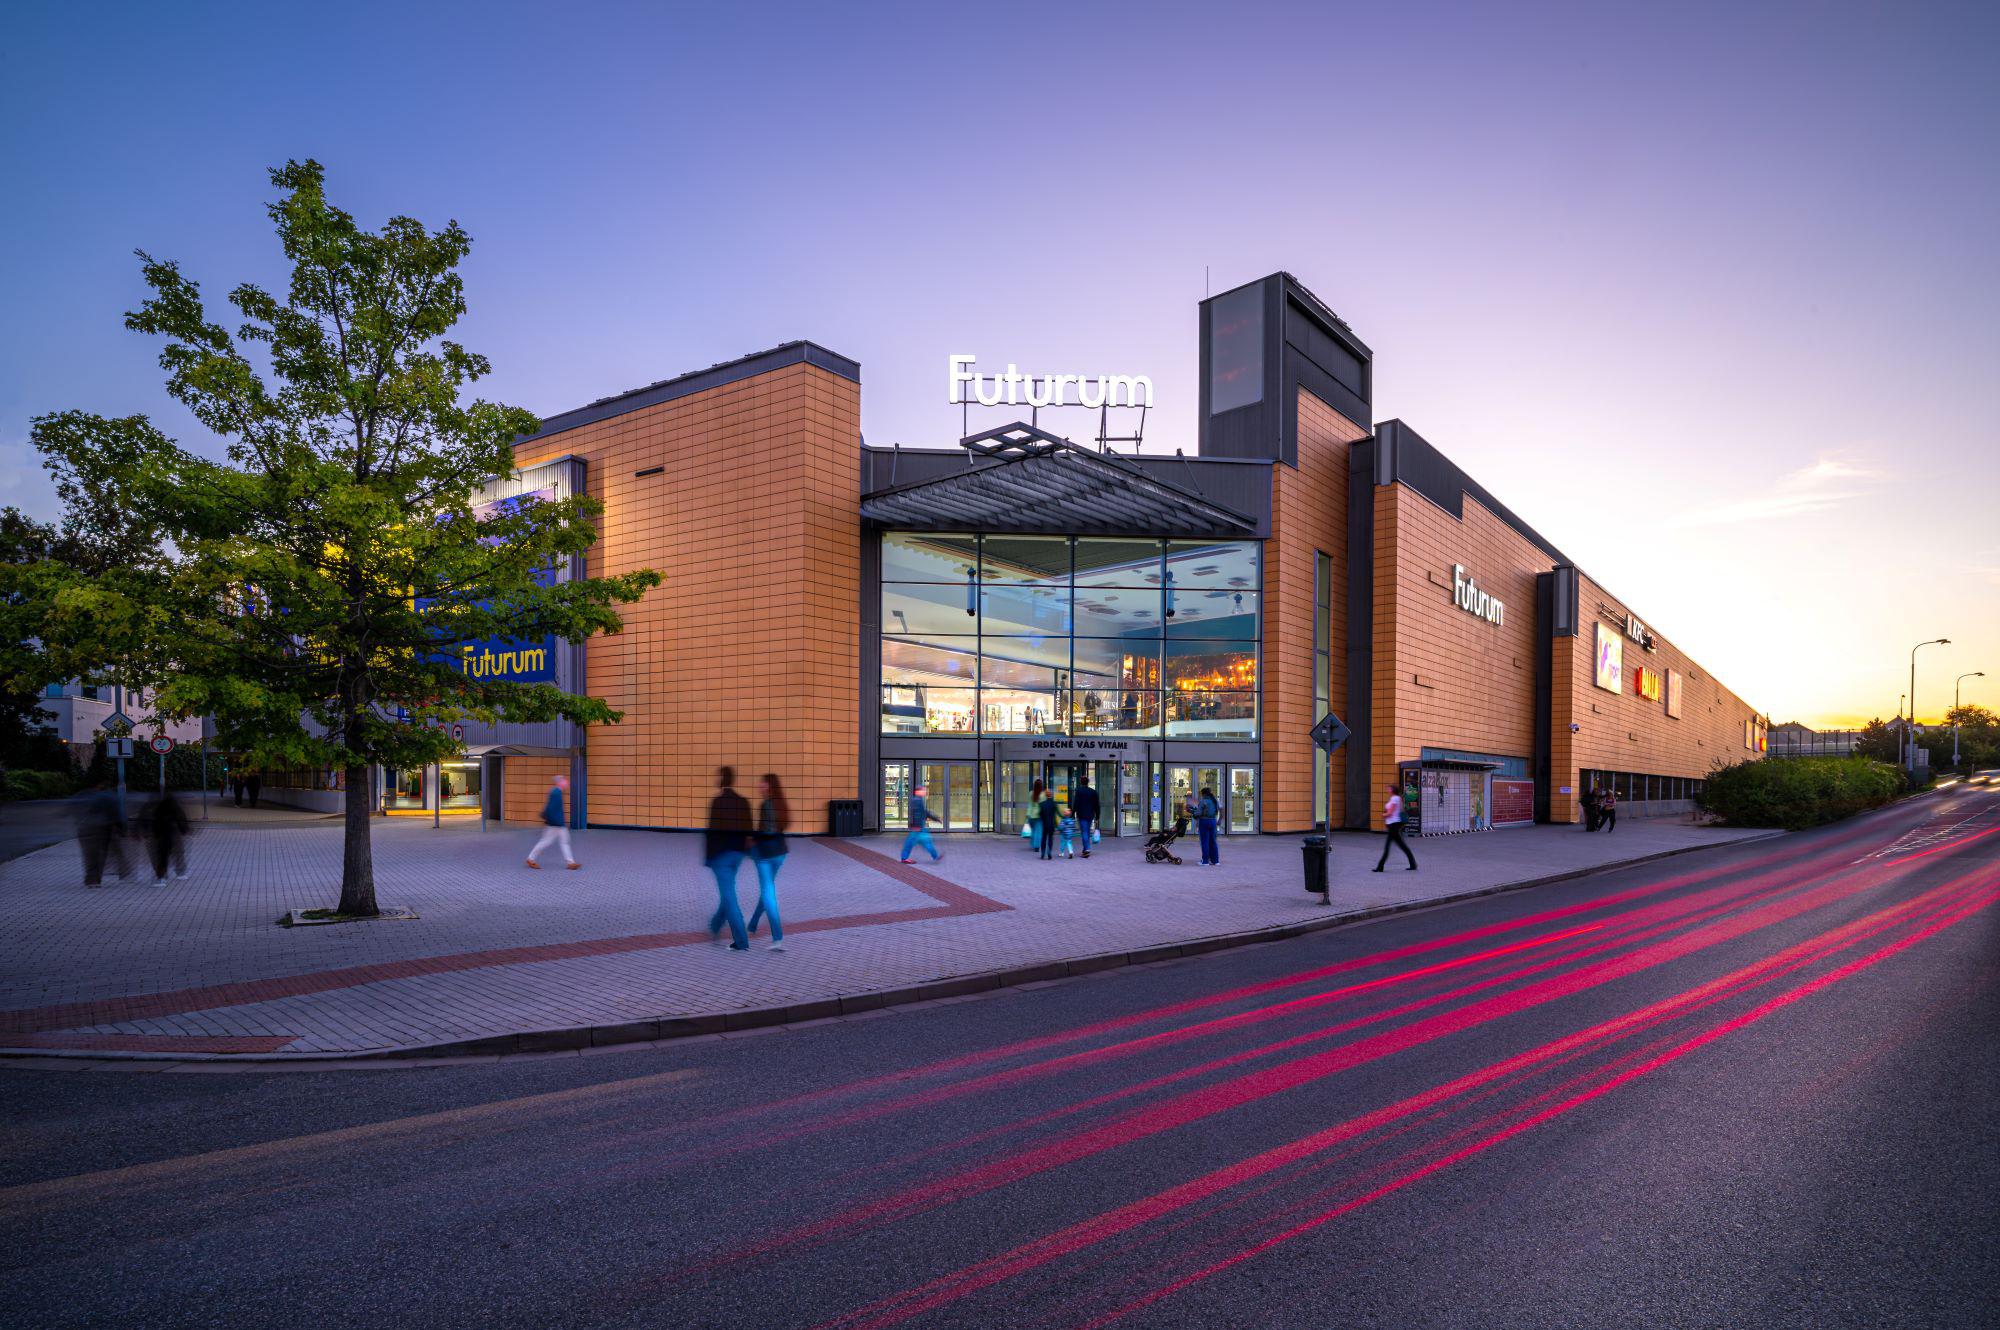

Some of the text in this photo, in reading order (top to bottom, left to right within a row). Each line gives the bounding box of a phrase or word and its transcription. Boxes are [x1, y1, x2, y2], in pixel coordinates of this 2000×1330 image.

[949, 354, 1153, 408] Futurum
[1454, 563, 1504, 626] Futurum
[463, 645, 545, 678] Futurum
[1076, 739, 1096, 749] VÁS
[1098, 739, 1128, 750] VÍTÁME
